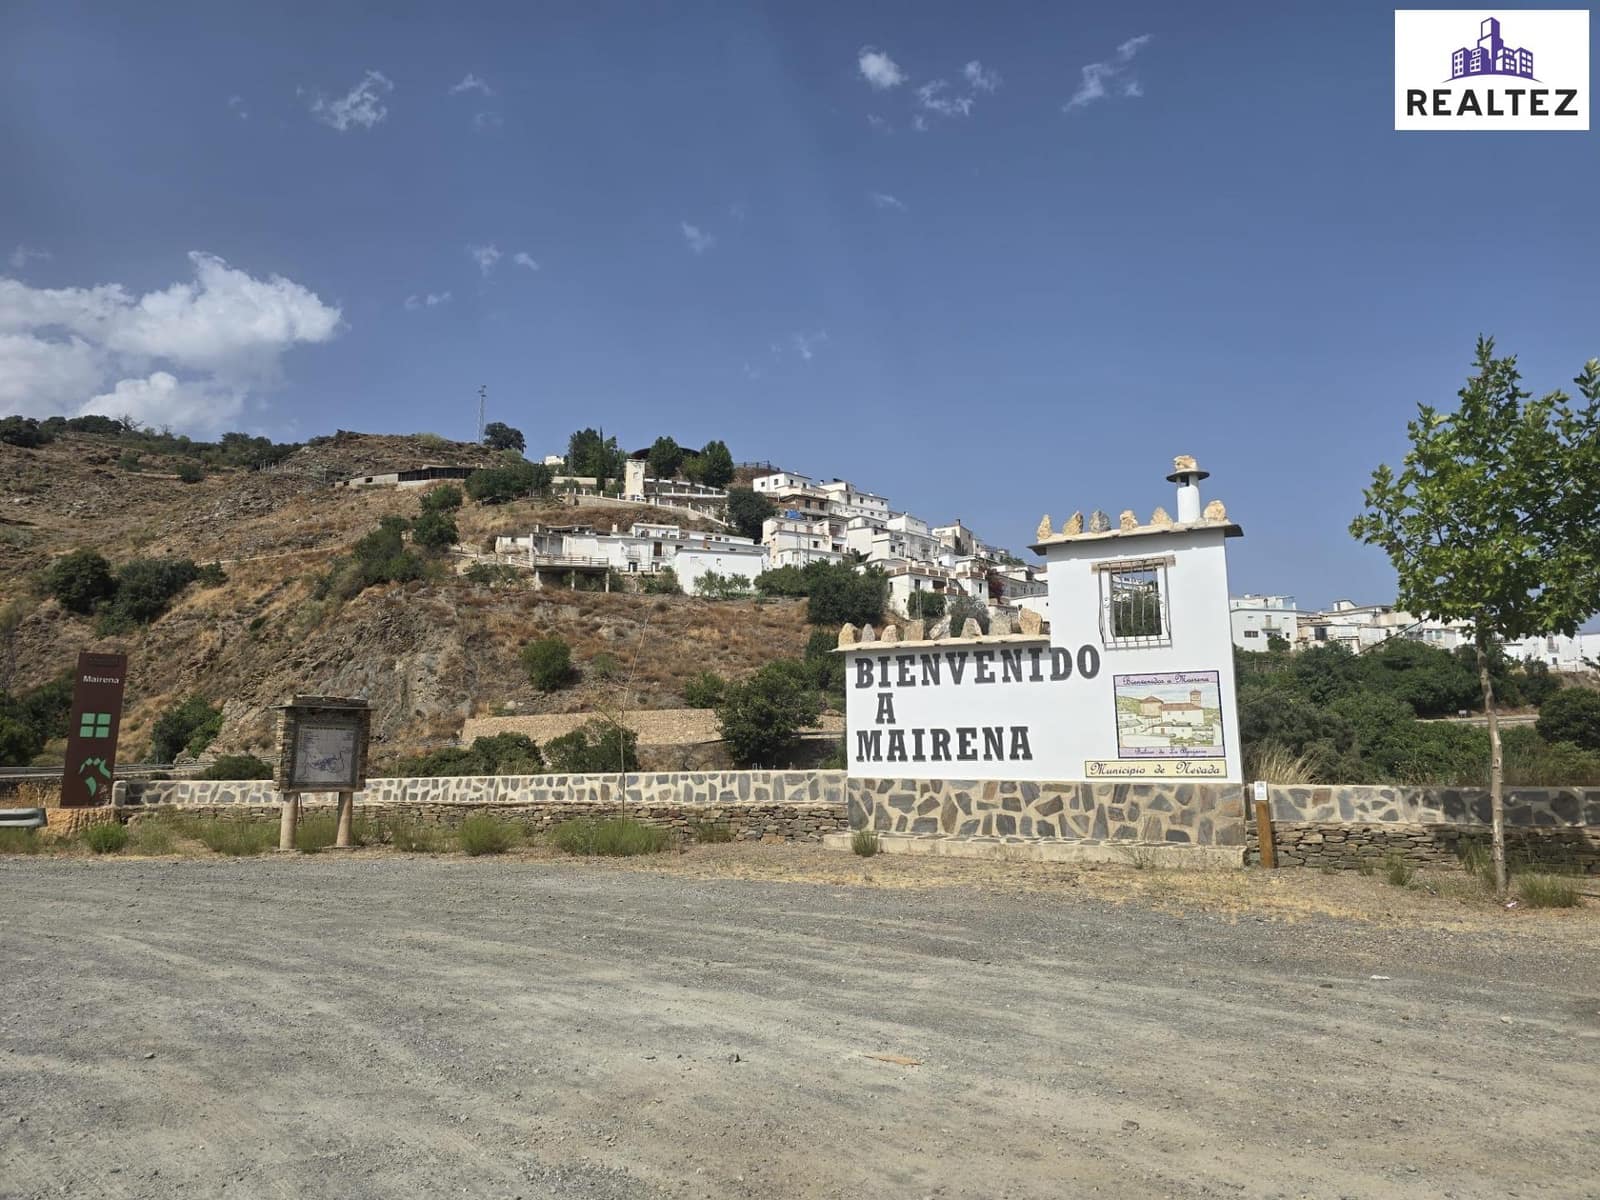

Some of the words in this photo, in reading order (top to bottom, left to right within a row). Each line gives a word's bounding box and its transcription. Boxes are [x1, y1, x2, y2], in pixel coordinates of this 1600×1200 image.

[82, 674, 120, 685] Mairena
[855, 644, 1100, 689] BIENVENIDO
[875, 693, 896, 724] A
[856, 726, 1033, 762] MAIRENA
[1090, 762, 1146, 776] Municipio
[1154, 763, 1165, 775] de
[1175, 761, 1220, 775] Nevada
